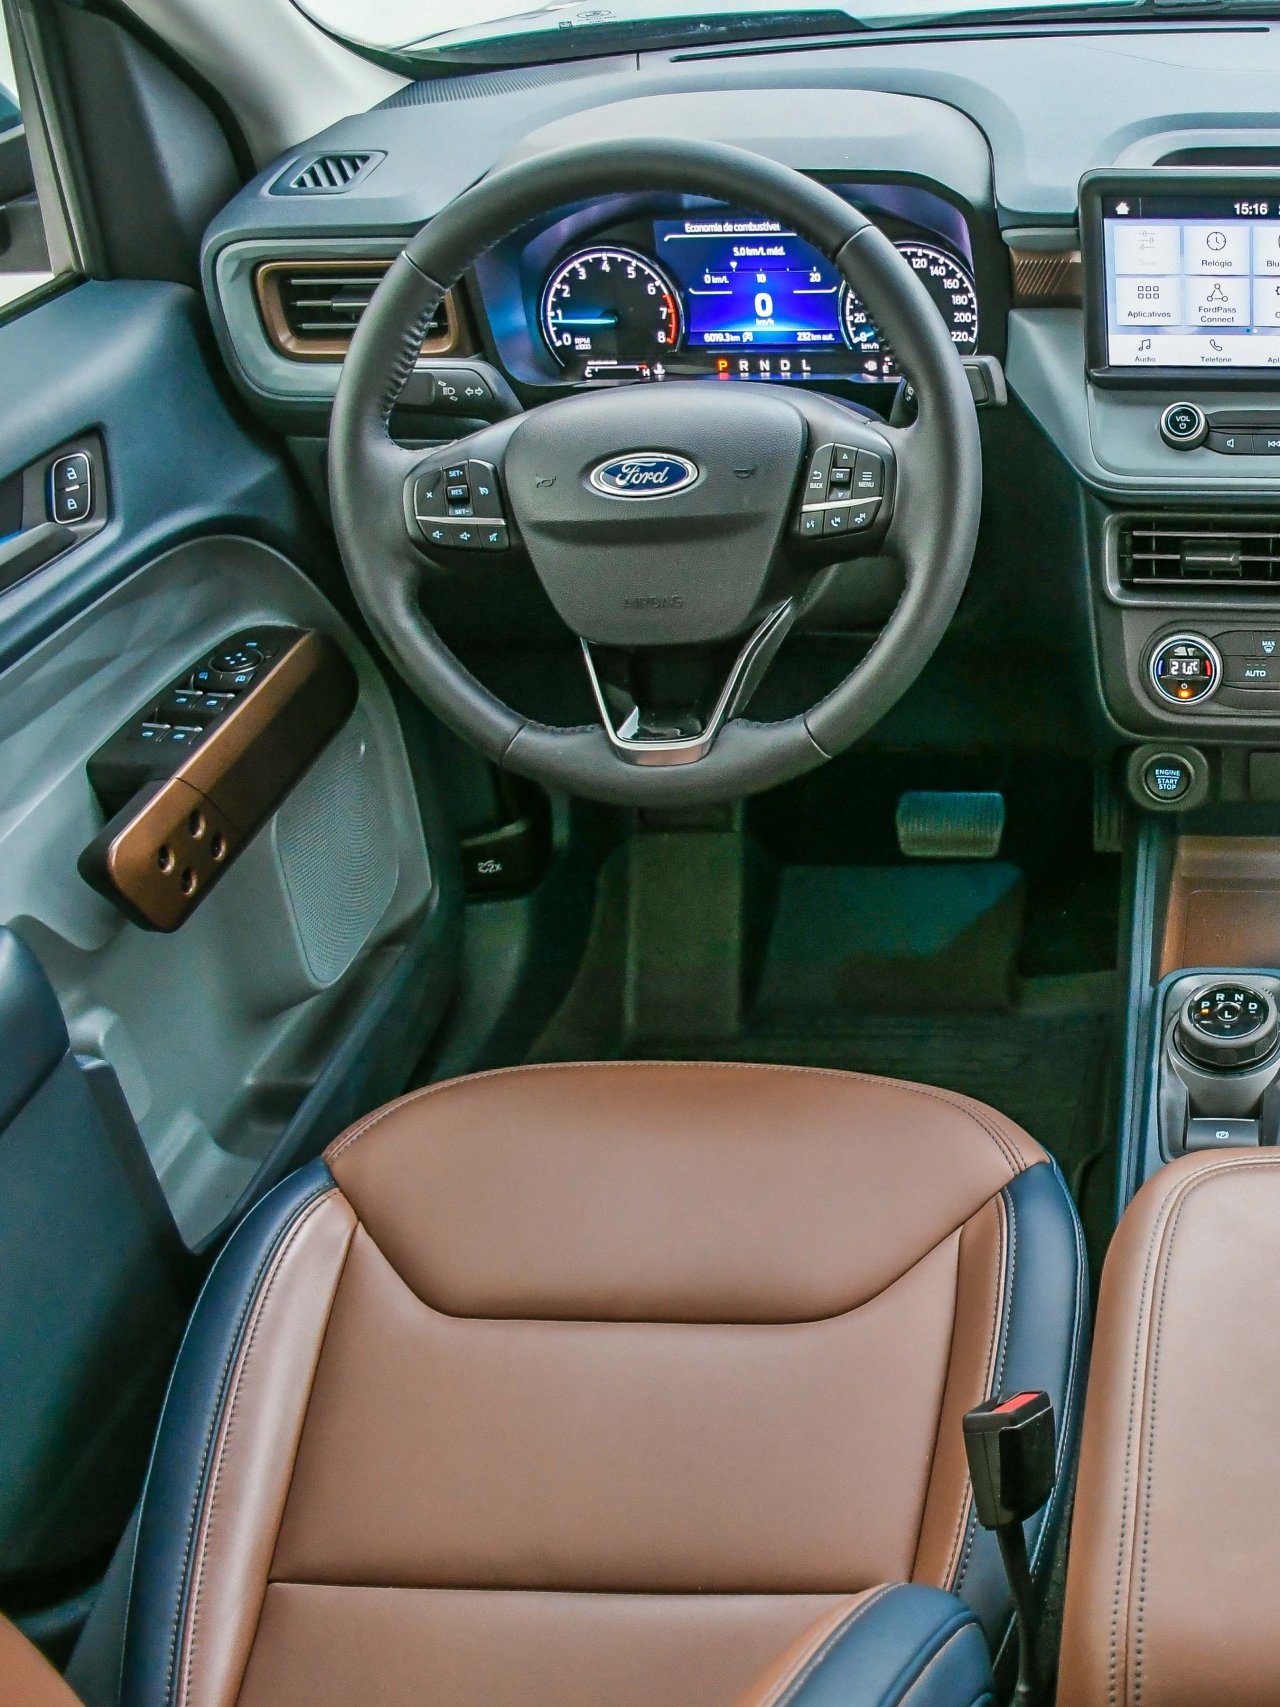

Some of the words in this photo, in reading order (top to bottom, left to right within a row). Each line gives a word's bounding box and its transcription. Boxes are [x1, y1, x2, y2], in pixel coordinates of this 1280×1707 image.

[1234, 202, 1268, 215] 15:16
[684, 223, 722, 233] Economia
[723, 222, 733, 232] de
[734, 221, 781, 232] combustível
[601, 261, 611, 273] 4
[912, 258, 928, 269] 120
[1201, 259, 1233, 268] Relógio
[578, 268, 587, 280] 3
[627, 267, 636, 279] 5
[929, 266, 946, 277] 140
[704, 274, 711, 284] 0
[756, 274, 767, 283] 10
[810, 273, 821, 283] 20
[943, 278, 960, 289] 160
[562, 286, 571, 297] 2
[648, 284, 656, 295] 6
[754, 293, 774, 317] 0
[951, 295, 968, 305] 180
[556, 309, 563, 321] 1
[659, 307, 667, 319] 7
[1127, 310, 1171, 318] Aplicativos
[1198, 306, 1237, 314] FordPass
[755, 318, 775, 326] km/h
[854, 313, 866, 323] 20
[954, 313, 972, 323] 200
[562, 334, 571, 345] 0
[657, 331, 666, 343] 8
[951, 331, 968, 342] 220
[717, 359, 728, 371] P
[739, 359, 749, 371] R
[760, 359, 770, 371] N
[780, 359, 791, 371] D
[802, 358, 811, 371] L
[585, 369, 593, 378] C
[642, 368, 651, 377] H
[615, 462, 670, 486] Ford
[1216, 993, 1225, 1001] R
[1234, 993, 1244, 1001] N
[1248, 1002, 1258, 1010] D
[1224, 1010, 1232, 1018] L
